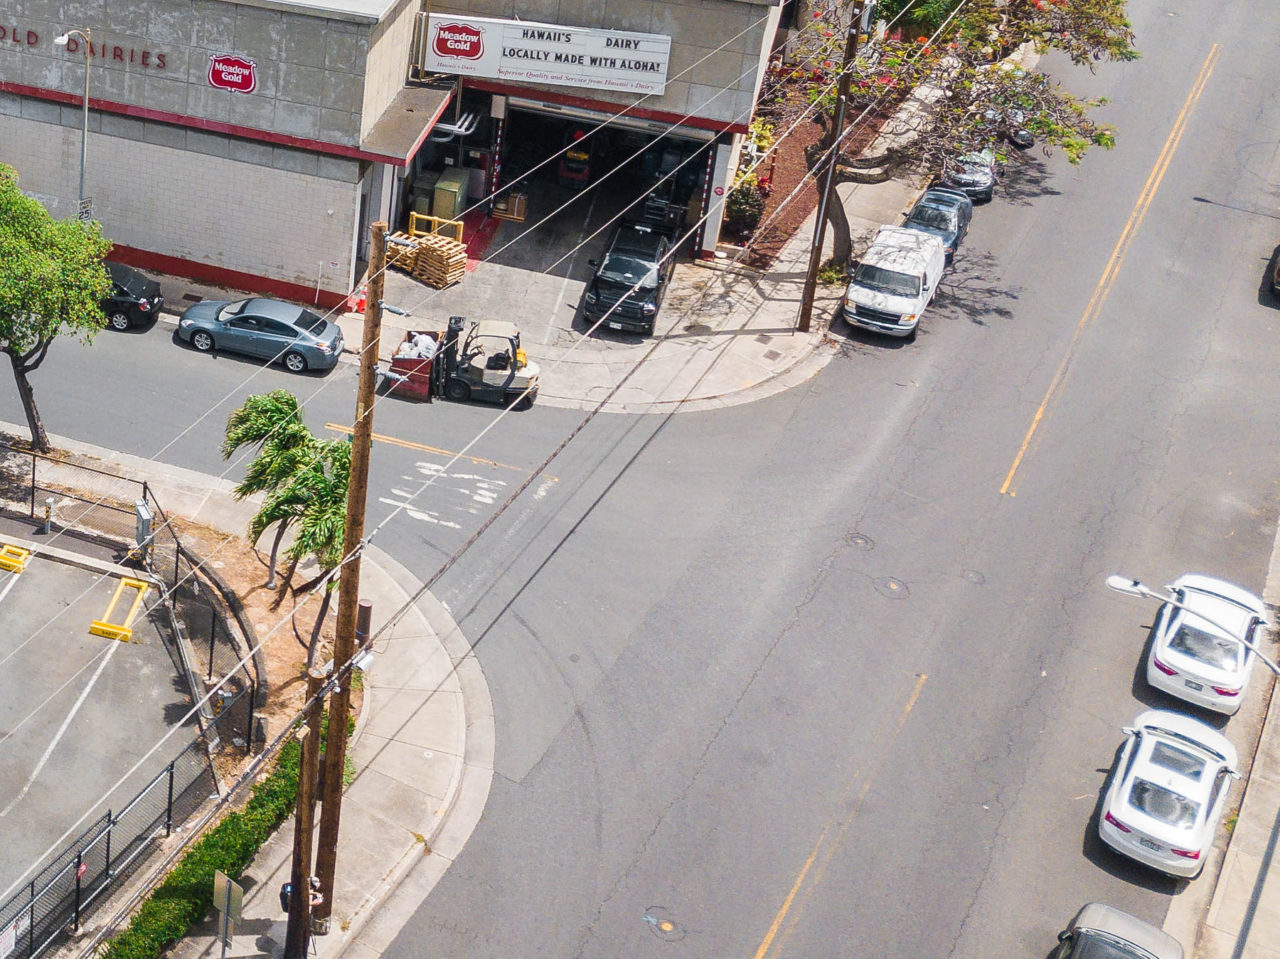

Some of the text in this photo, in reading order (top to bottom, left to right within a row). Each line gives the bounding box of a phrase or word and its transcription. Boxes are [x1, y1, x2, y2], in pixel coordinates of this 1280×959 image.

[439, 30, 479, 43] Meadow
[522, 29, 640, 50] HAWAII'S DAIRY
[66, 38, 166, 69] DAIRIES
[447, 40, 470, 51] Gold
[502, 47, 661, 72] LOCALLY MADE WITH ALOHA!
[215, 62, 251, 76] Meadow
[221, 72, 242, 83] Gold
[497, 68, 524, 77] Superior
[526, 71, 549, 80] Quality
[564, 74, 587, 83] Service
[587, 77, 603, 86] from
[635, 82, 655, 91] Dairy
